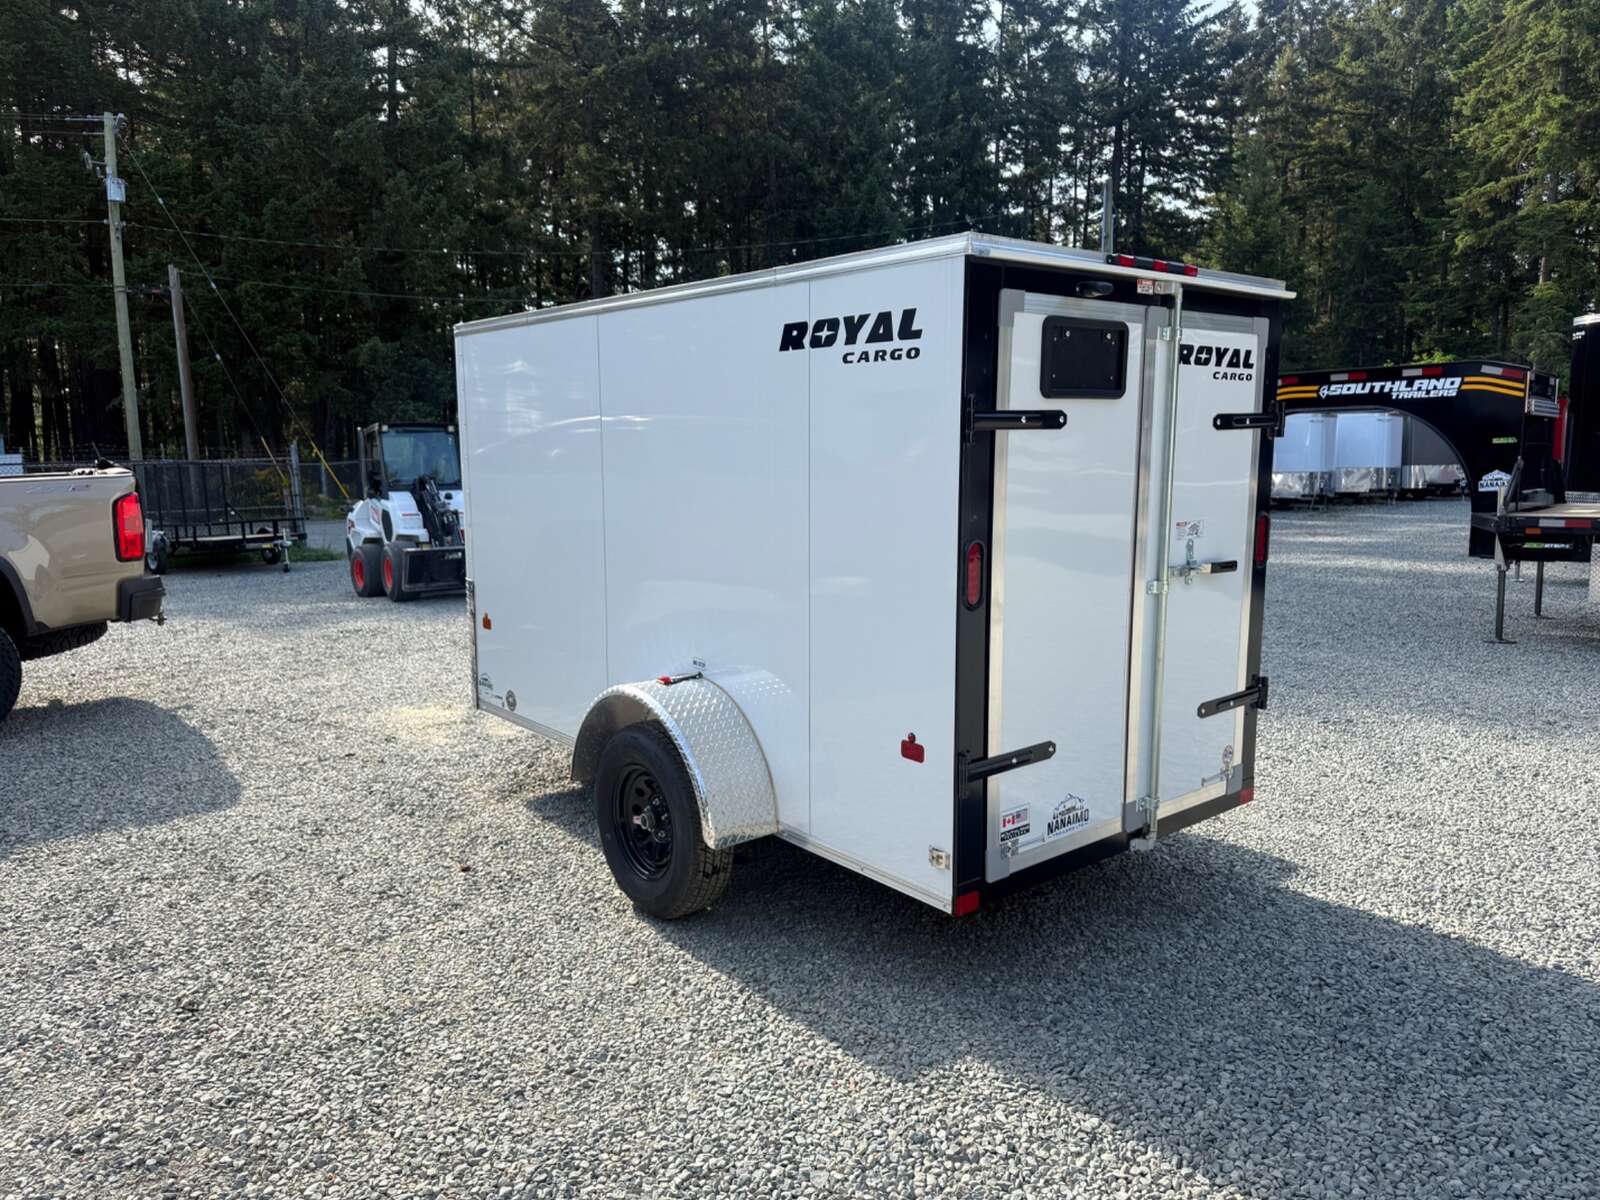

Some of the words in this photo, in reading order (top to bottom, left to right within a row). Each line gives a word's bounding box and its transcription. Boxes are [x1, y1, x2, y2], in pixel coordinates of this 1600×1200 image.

[778, 308, 923, 352] ROYAL
[842, 347, 921, 364] CARGO
[1179, 344, 1254, 369] ROYAL
[1213, 371, 1253, 381] CARGO
[1328, 377, 1462, 395] SOUTHLAND
[1391, 389, 1458, 399] TRAILERS
[1047, 808, 1089, 836] NANAIMO
